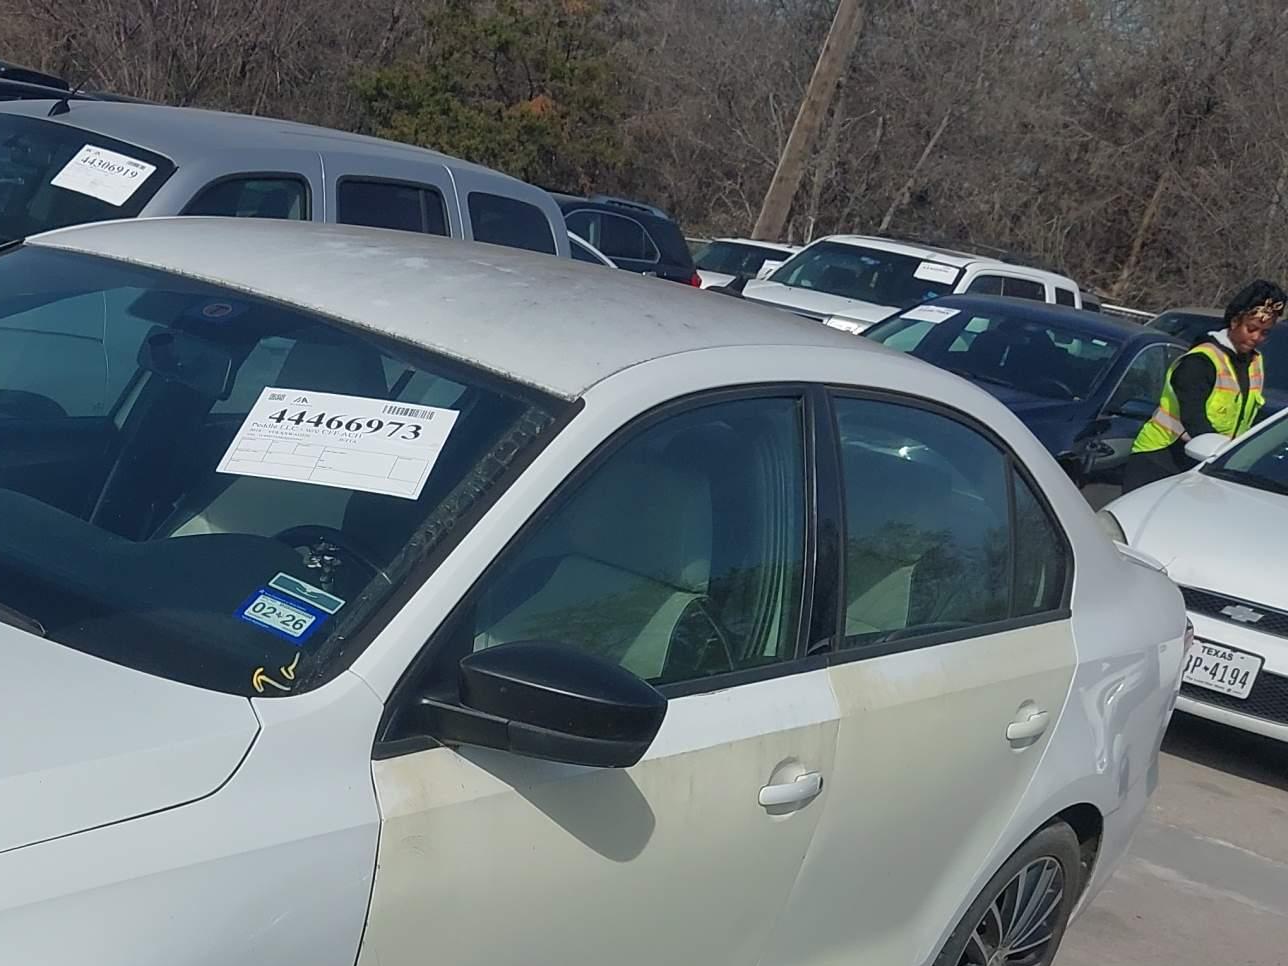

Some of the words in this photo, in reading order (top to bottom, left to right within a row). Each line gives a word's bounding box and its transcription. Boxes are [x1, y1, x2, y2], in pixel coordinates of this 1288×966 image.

[80, 155, 139, 179] 44306919
[268, 408, 423, 441] 44466973
[252, 602, 277, 618] 02
[280, 614, 307, 631] 26
[1201, 645, 1234, 661] TEXAS
